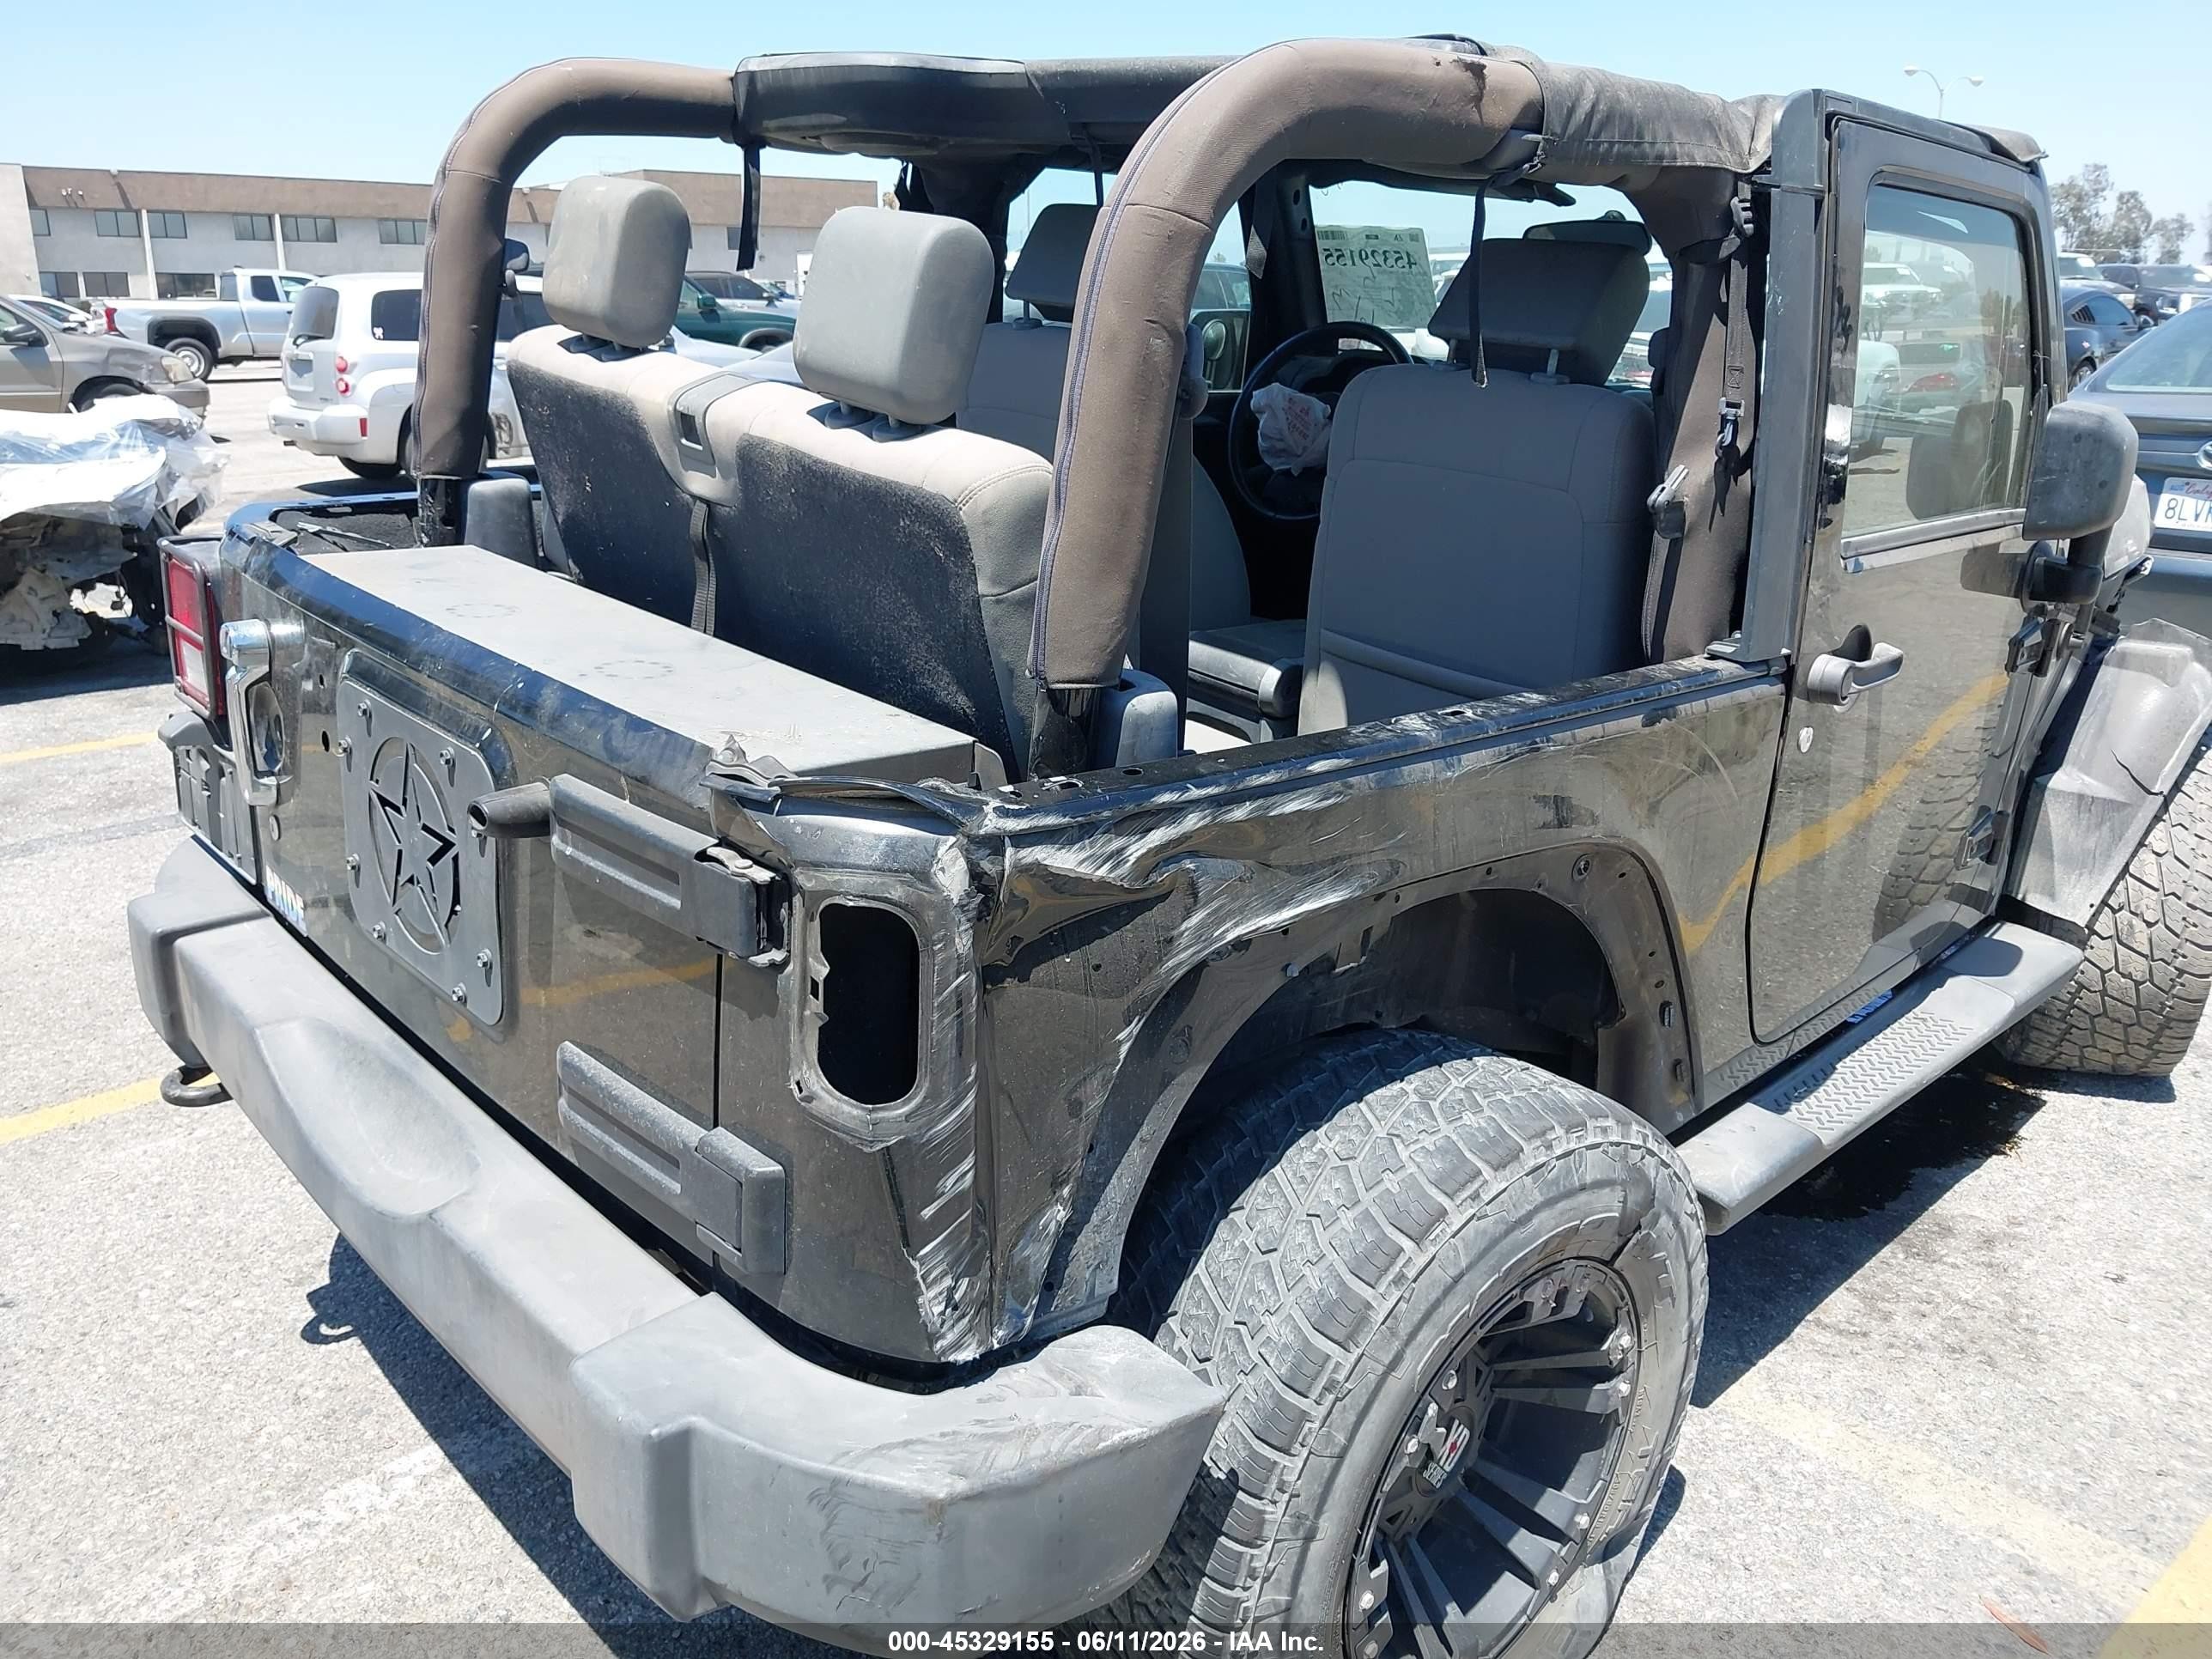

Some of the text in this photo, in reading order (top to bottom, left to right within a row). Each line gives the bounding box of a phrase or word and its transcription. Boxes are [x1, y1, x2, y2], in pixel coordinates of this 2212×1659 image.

[265, 865, 307, 933] PRIDE
[1437, 1419, 1470, 1473] XD
[1423, 1462, 1448, 1489] SERIES
